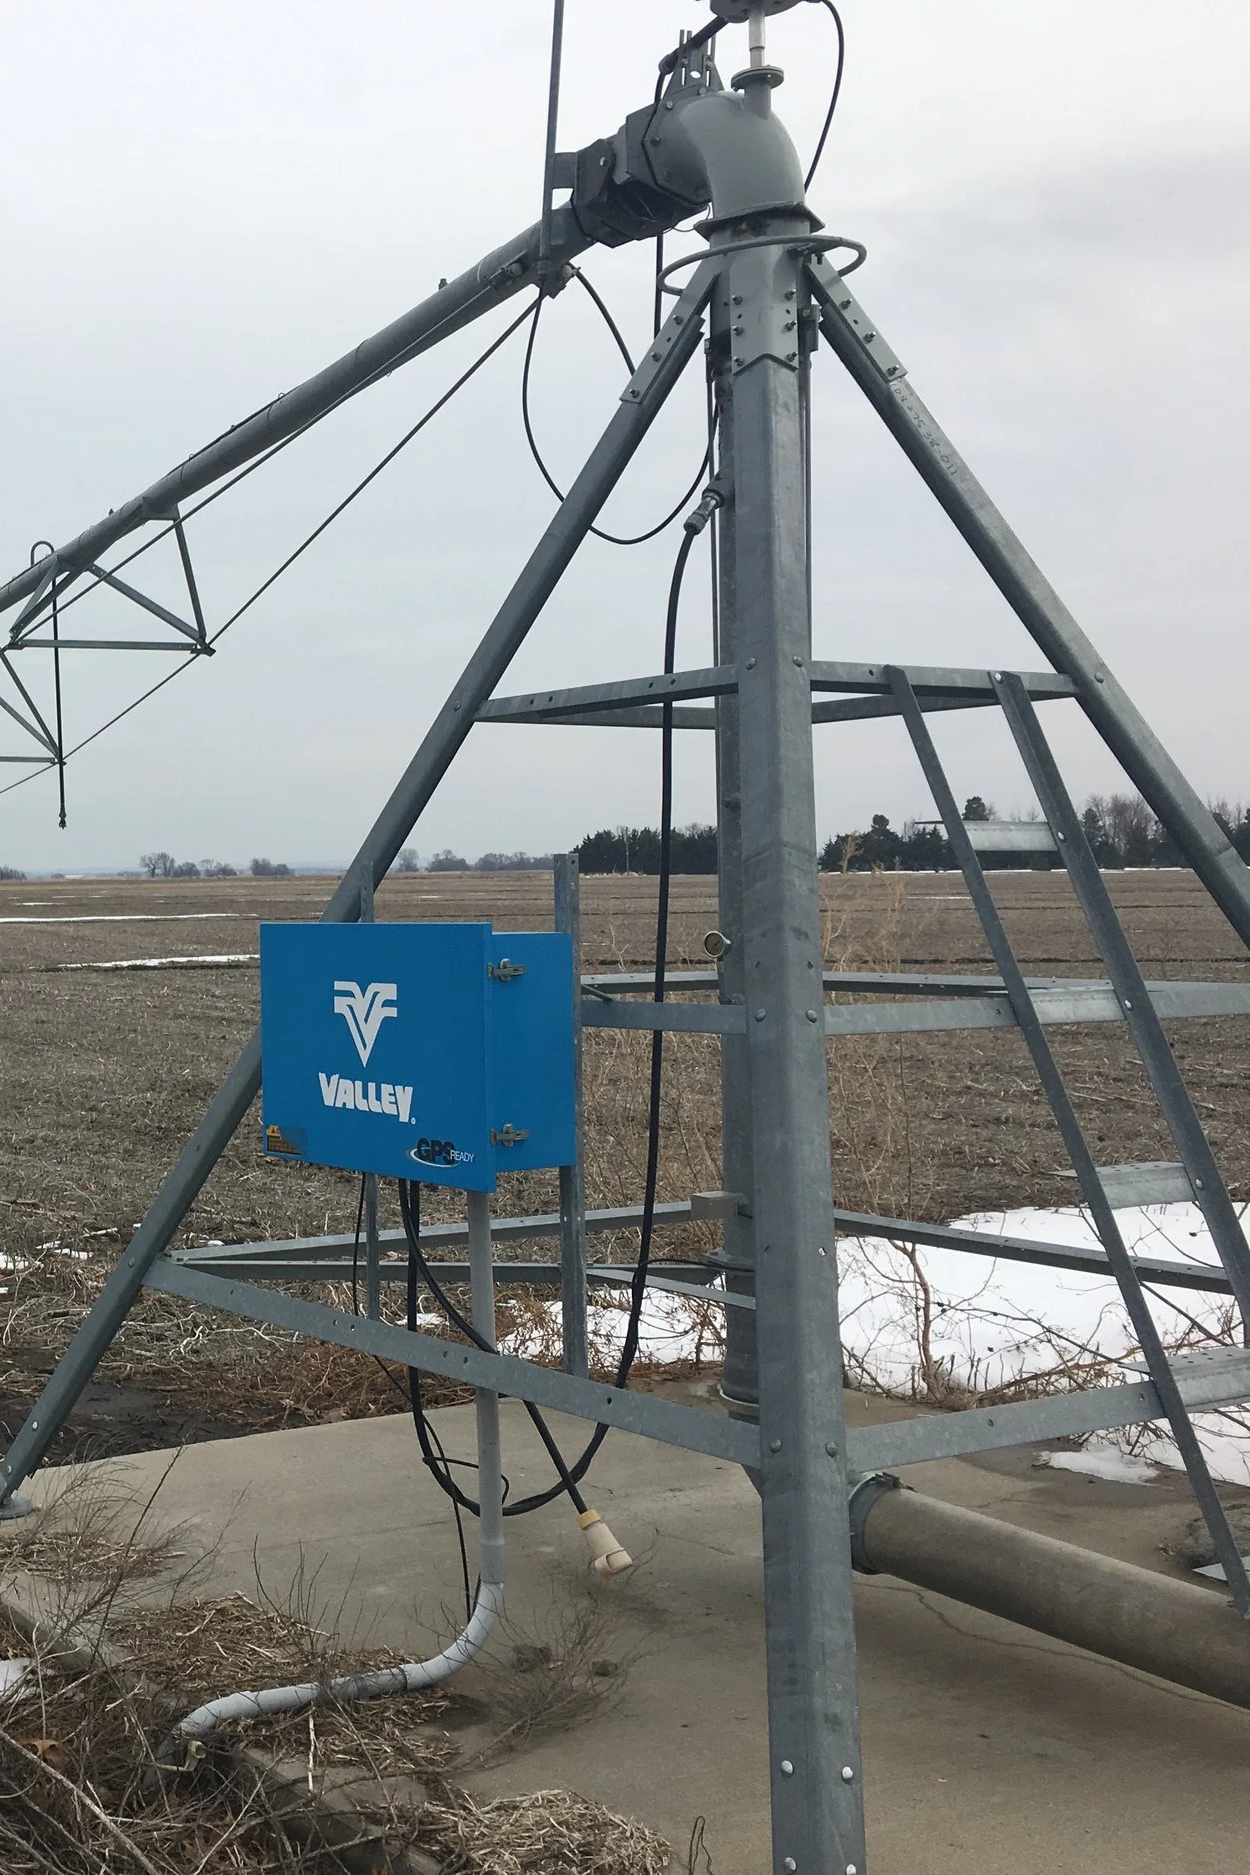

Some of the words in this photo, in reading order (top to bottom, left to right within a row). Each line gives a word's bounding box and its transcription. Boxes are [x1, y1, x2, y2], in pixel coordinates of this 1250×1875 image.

[318, 1072, 413, 1122] VALLEY
[417, 1138, 455, 1164] GPS
[450, 1149, 474, 1162] READY
